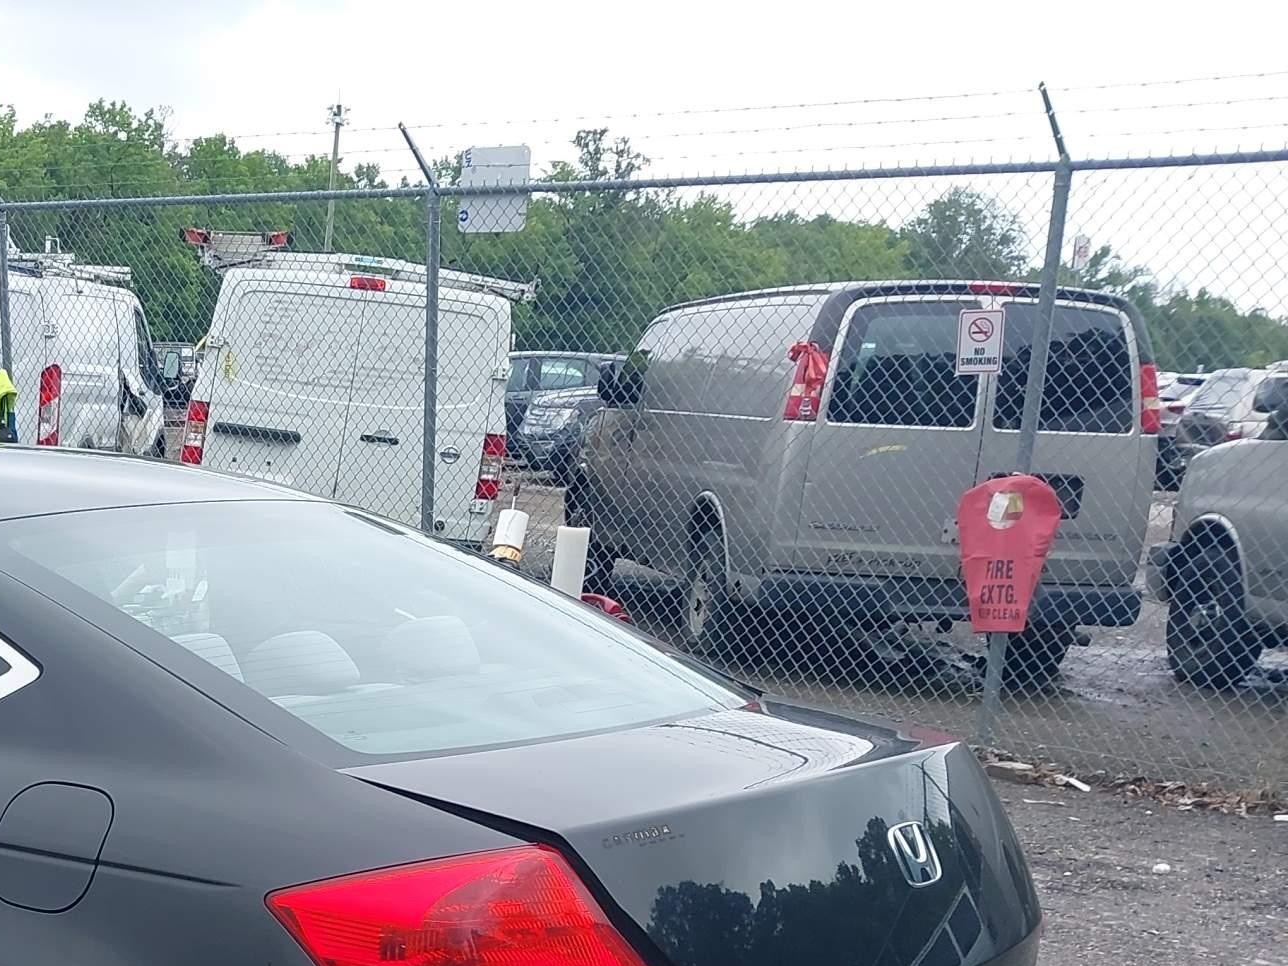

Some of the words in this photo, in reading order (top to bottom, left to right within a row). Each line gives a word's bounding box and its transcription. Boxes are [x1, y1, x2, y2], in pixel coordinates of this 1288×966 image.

[973, 347, 986, 356] NO
[960, 356, 998, 367] SMOKING
[985, 559, 1015, 579] FIRE
[992, 608, 1020, 620] CLEAR
